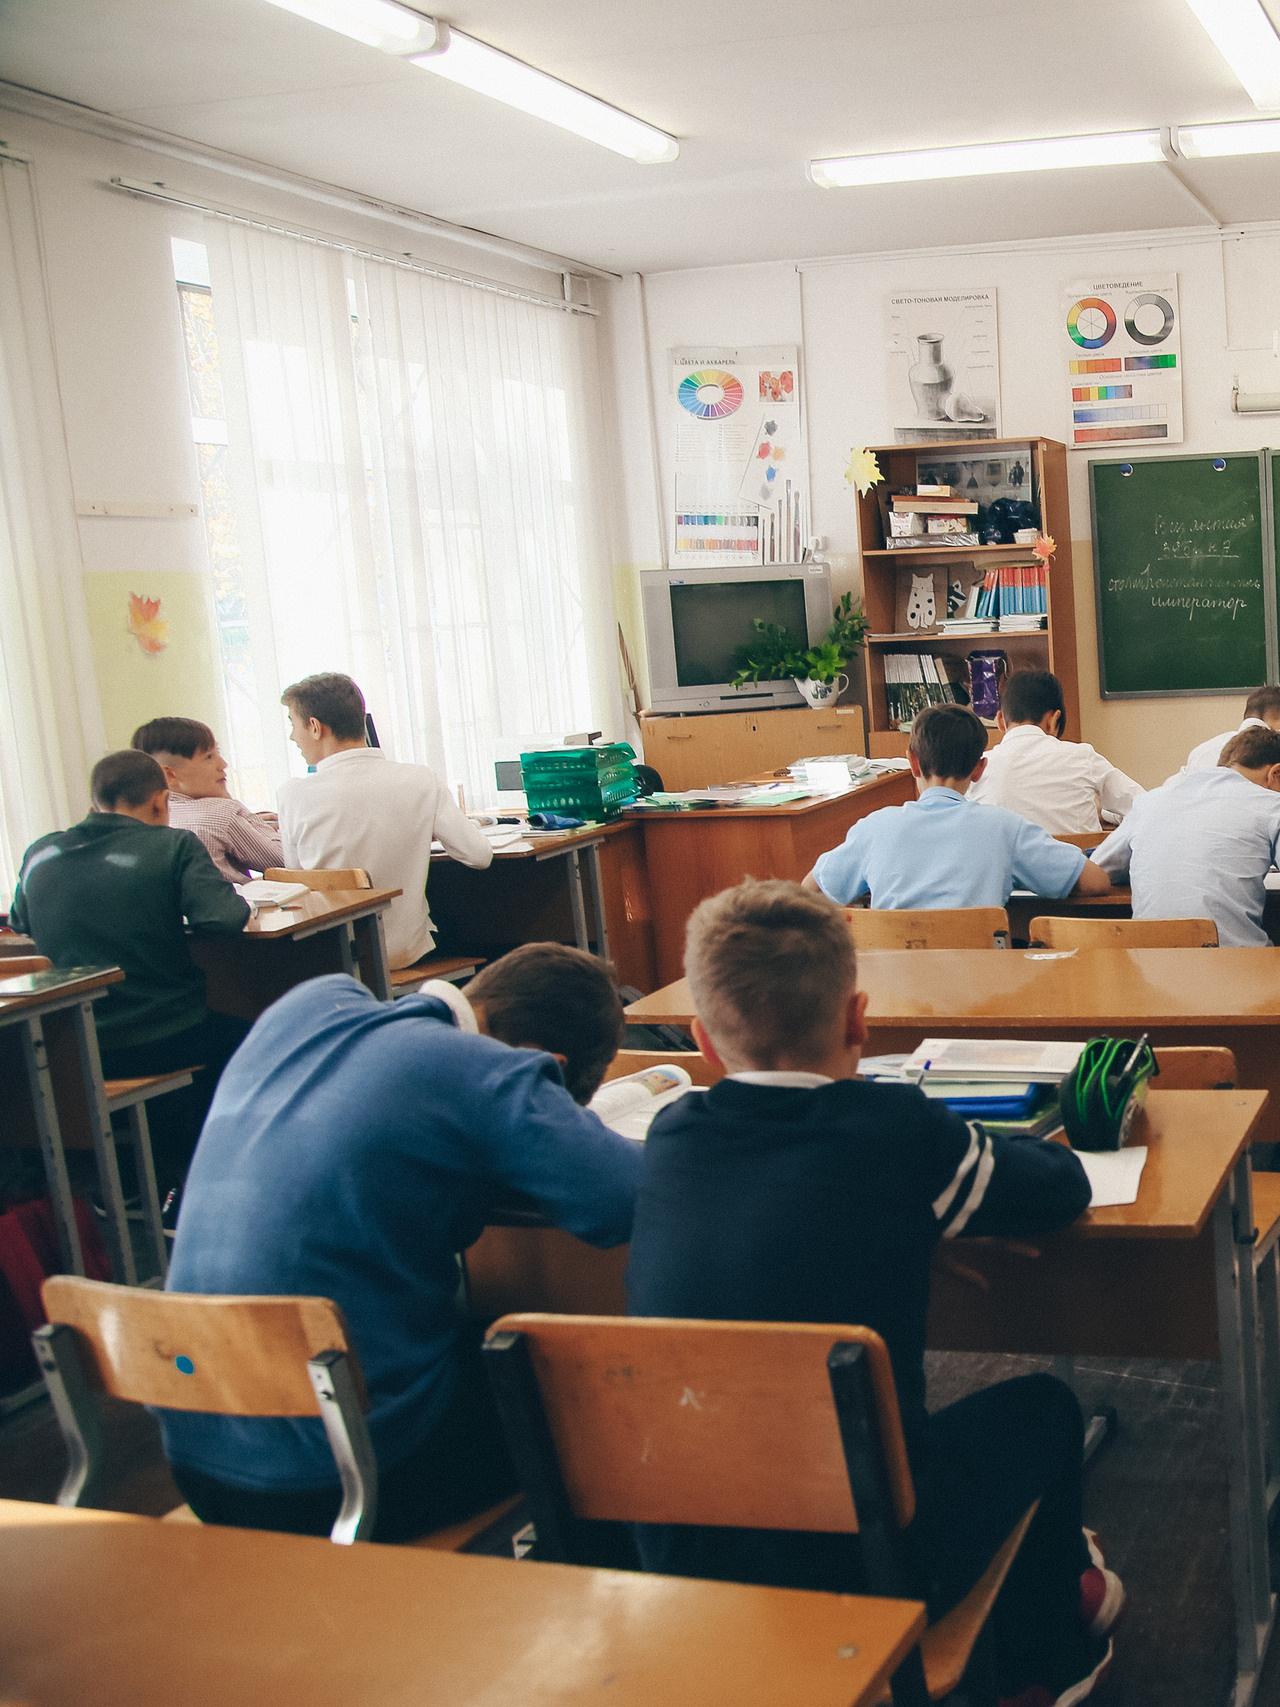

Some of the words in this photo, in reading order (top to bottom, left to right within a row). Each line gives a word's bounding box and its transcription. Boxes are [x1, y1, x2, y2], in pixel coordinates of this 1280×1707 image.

[1093, 281, 1143, 290] ЦВЕТОВЕДЕНИЕ
[891, 296, 943, 305] СВЕТО-ТОНОВАЯ
[1151, 596, 1248, 622] император
